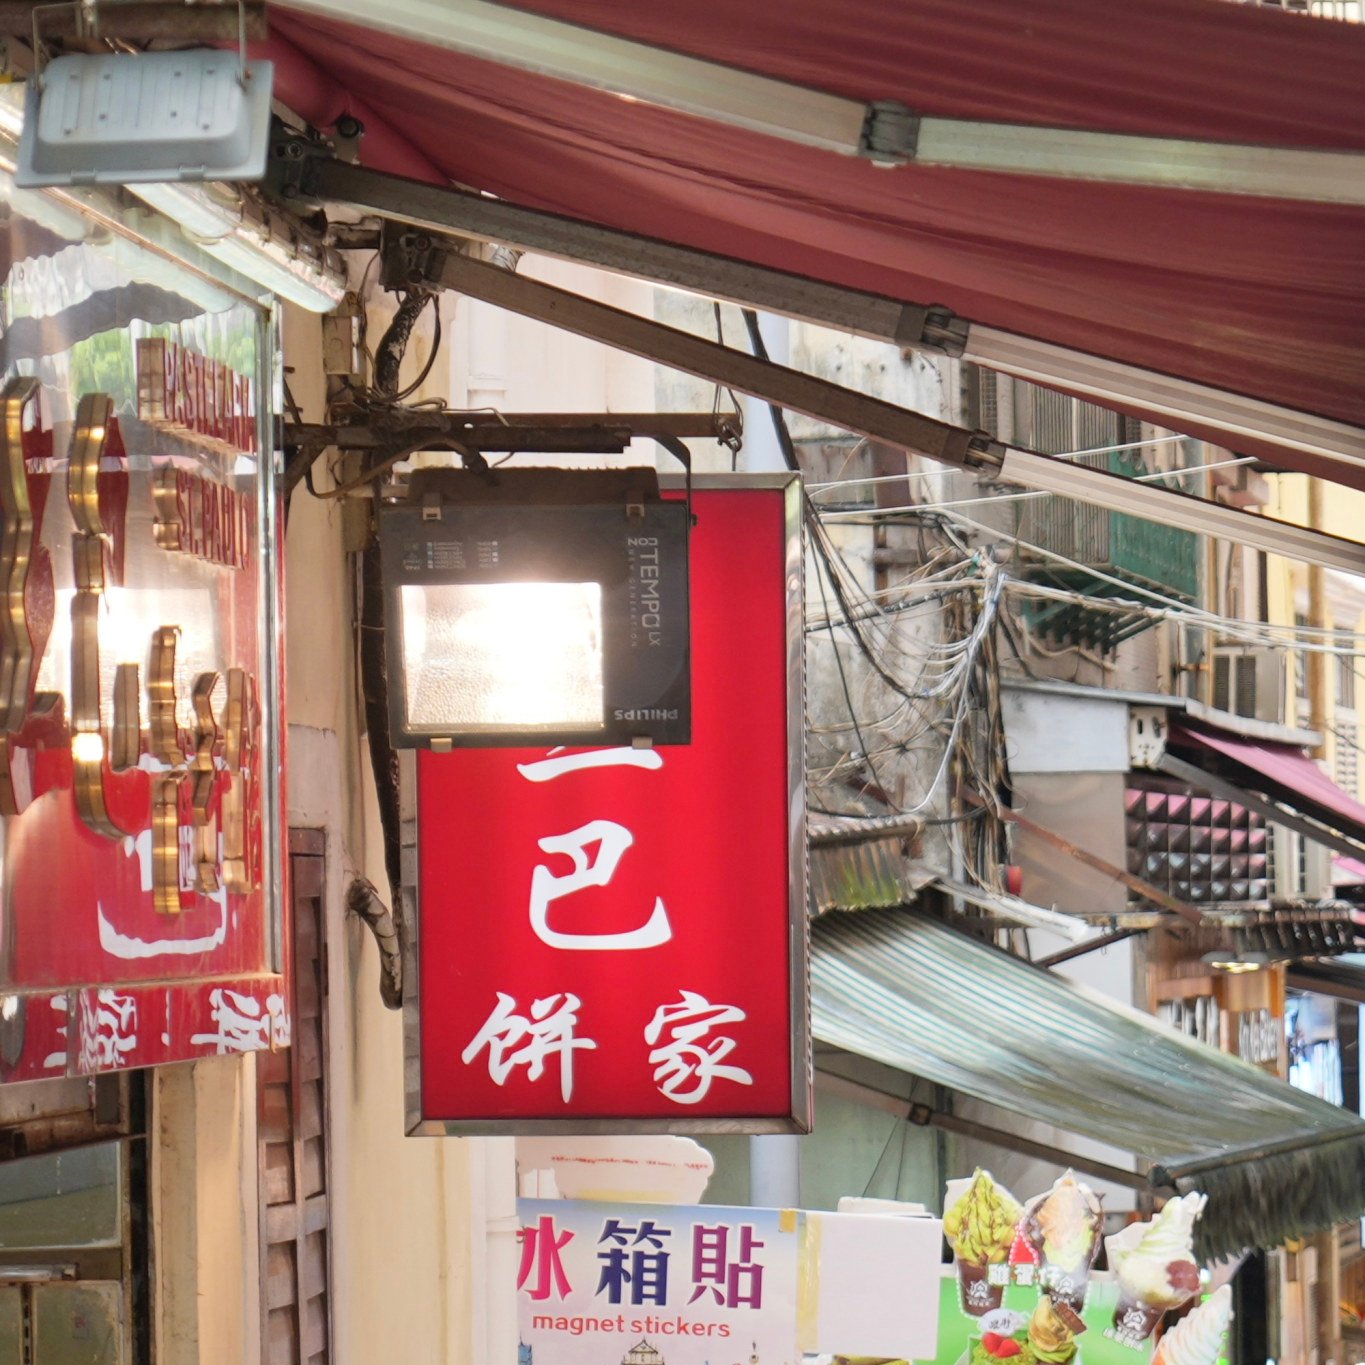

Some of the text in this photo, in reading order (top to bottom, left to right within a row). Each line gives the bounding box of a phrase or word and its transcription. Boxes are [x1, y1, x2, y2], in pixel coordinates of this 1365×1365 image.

[640, 548, 660, 628] TEMPO
[614, 708, 679, 721] PHILIPS
[461, 990, 753, 1104] 餅家
[516, 1216, 765, 1309] 水箱貼
[532, 1315, 731, 1337] magnet stickers
